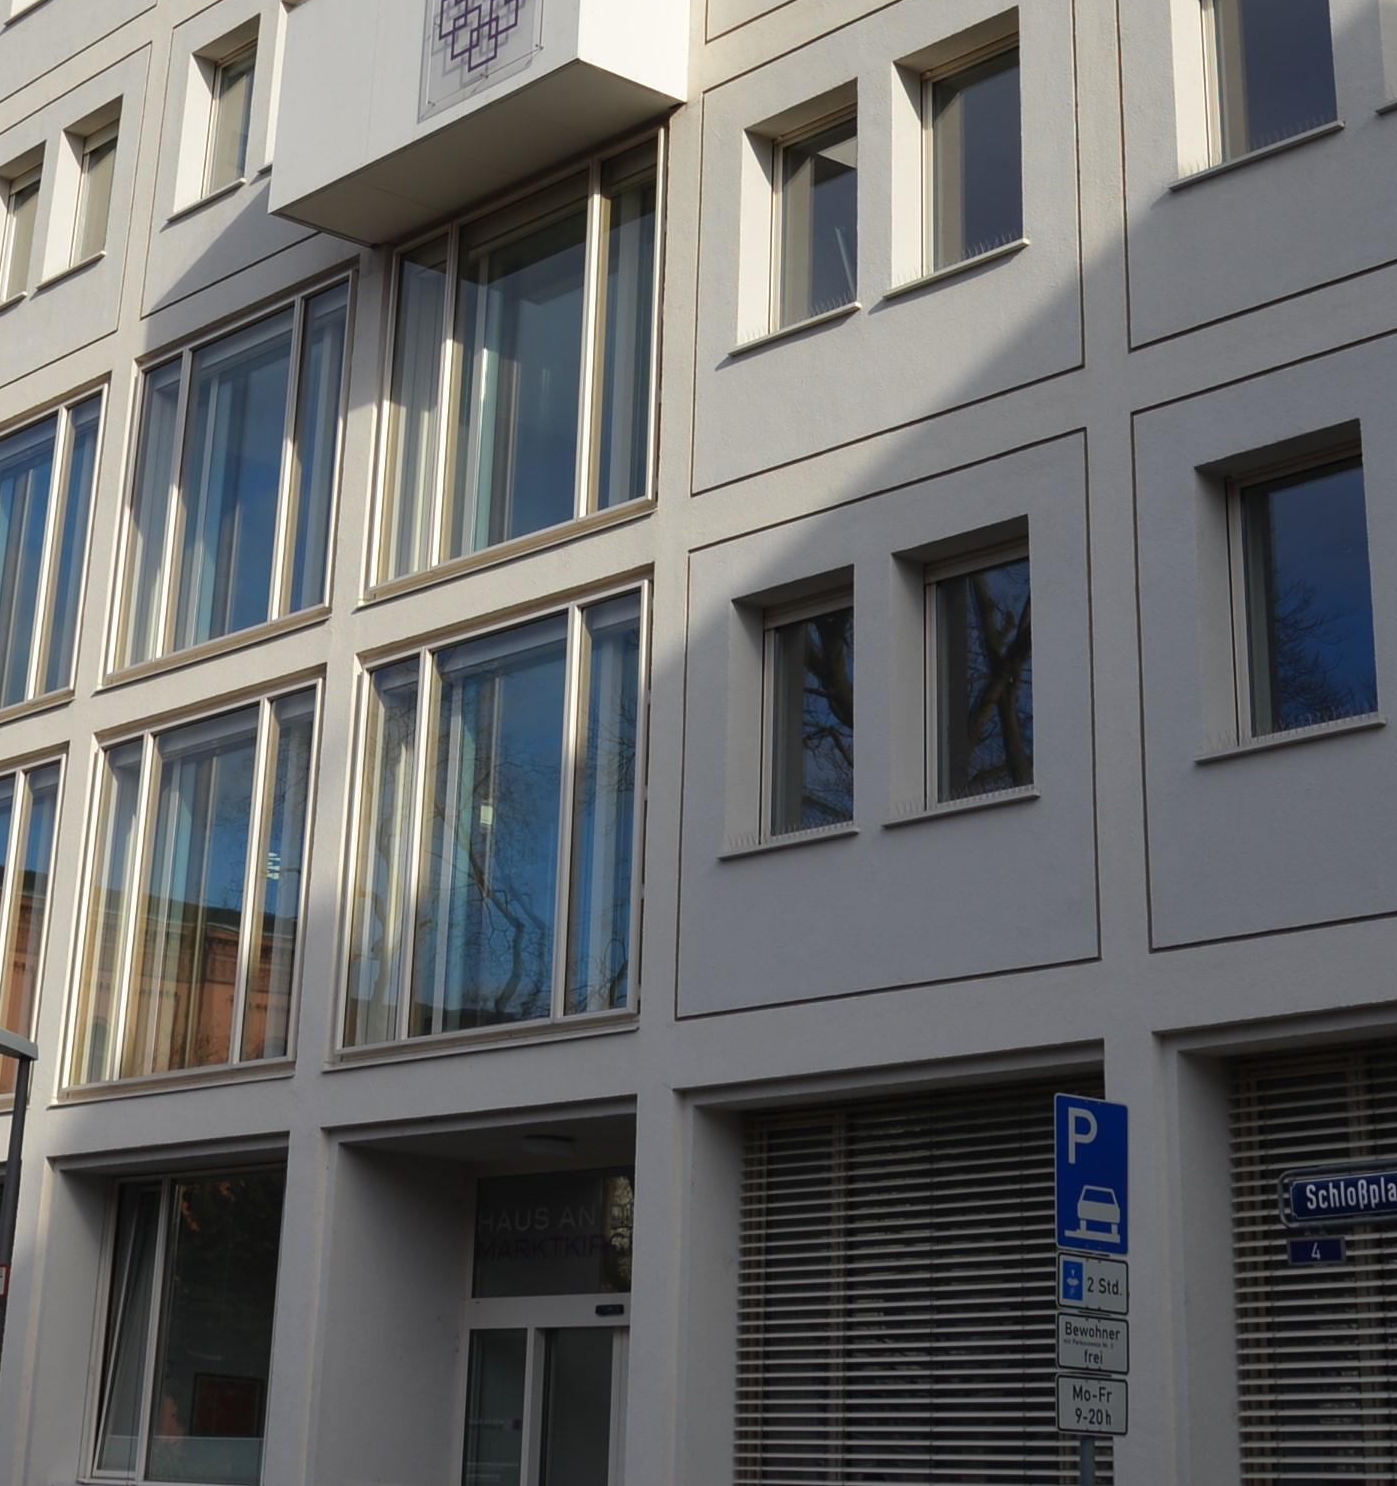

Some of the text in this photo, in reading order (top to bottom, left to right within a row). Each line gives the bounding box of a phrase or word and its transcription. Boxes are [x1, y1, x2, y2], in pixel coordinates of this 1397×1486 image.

[1067, 1107, 1098, 1164] P
[478, 1207, 549, 1233] HAUS
[559, 1203, 596, 1229] AN
[1311, 1242, 1321, 1259] 4
[1087, 1277, 1094, 1293] 2
[1099, 1278, 1122, 1296] Std.
[1065, 1321, 1120, 1340] Bewohner
[1084, 1349, 1103, 1365] frei
[1072, 1384, 1112, 1403] Mo-Fr
